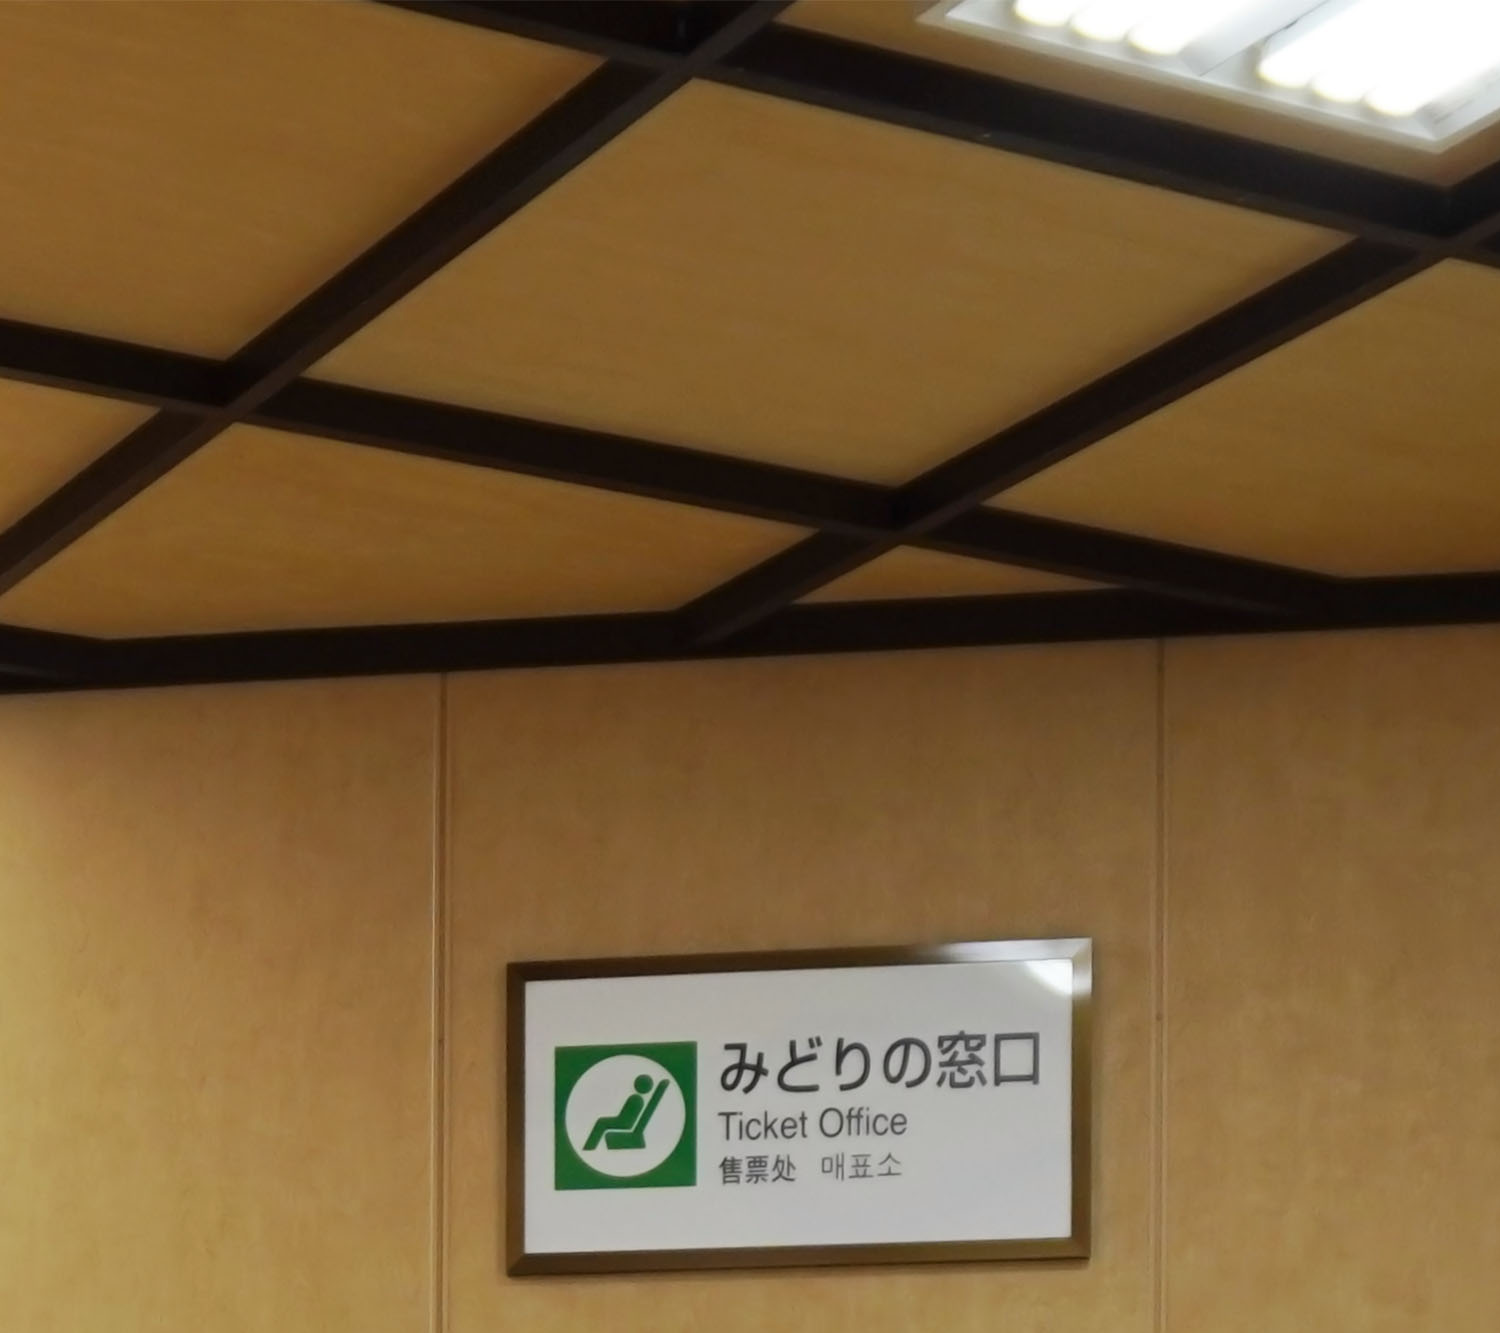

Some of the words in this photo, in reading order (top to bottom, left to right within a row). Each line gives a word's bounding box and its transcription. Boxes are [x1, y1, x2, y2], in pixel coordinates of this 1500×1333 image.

[719, 1030, 1040, 1094] みどりの窓口
[718, 1110, 808, 1141] Ticket
[818, 1107, 908, 1138] Office
[719, 1154, 796, 1185] 售票处
[821, 1151, 903, 1181] 매표소
